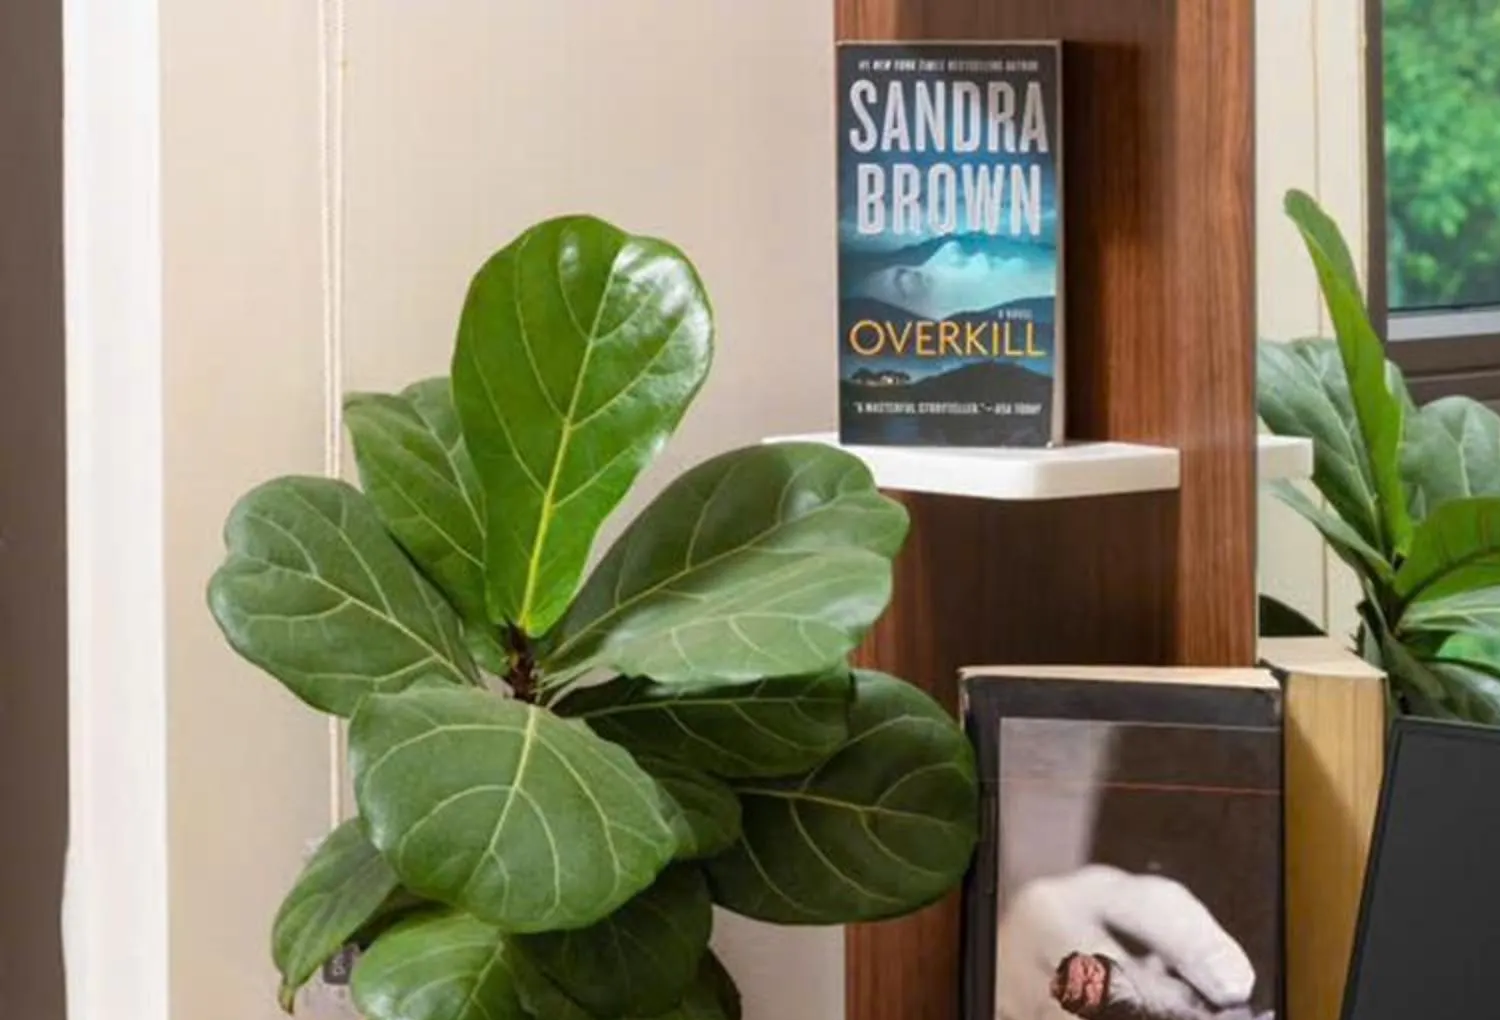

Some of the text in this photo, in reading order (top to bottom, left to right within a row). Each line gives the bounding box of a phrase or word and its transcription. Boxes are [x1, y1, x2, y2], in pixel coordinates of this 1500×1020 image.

[849, 79, 1049, 153] SANDRA
[856, 162, 1042, 236] BROWN
[850, 319, 1048, 357] OVERKILL
